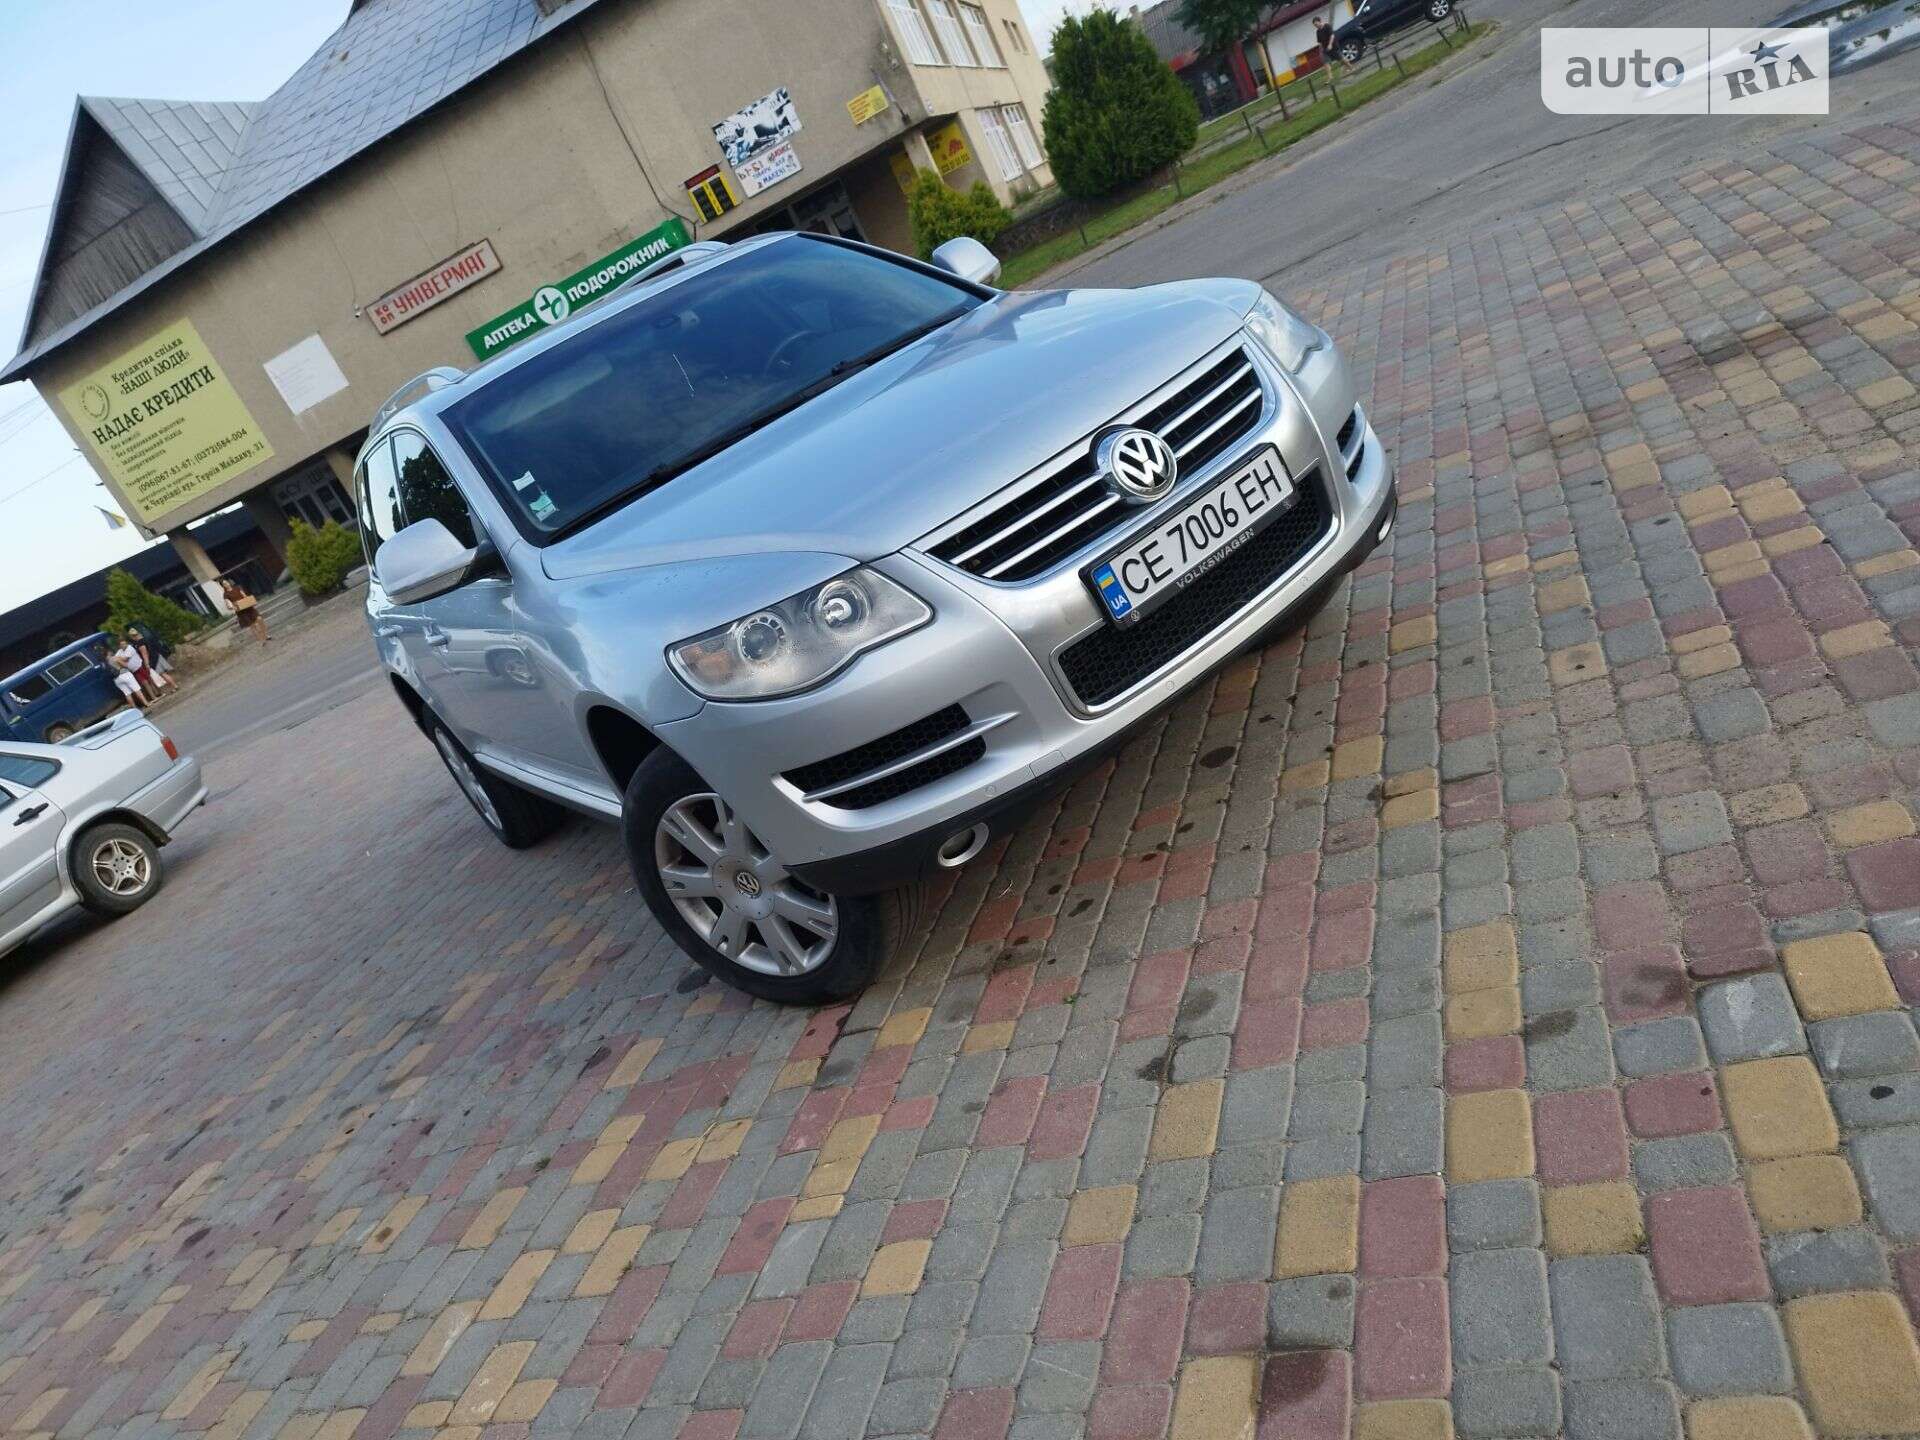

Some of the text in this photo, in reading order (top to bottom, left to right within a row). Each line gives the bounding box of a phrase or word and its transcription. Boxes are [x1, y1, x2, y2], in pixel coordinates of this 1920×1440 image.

[393, 248, 486, 314] УНІВЕРМАГ
[483, 237, 672, 349] АПТЕКА ПОДОРОЖНИК
[111, 338, 183, 384] Кредитна спілка
[92, 406, 144, 444] НАДАЄ
[142, 365, 216, 417] КРЕДИТИ
[1110, 459, 1282, 611] UA CE 7006 EH
[1175, 527, 1256, 589] VOLKSWAGEN
